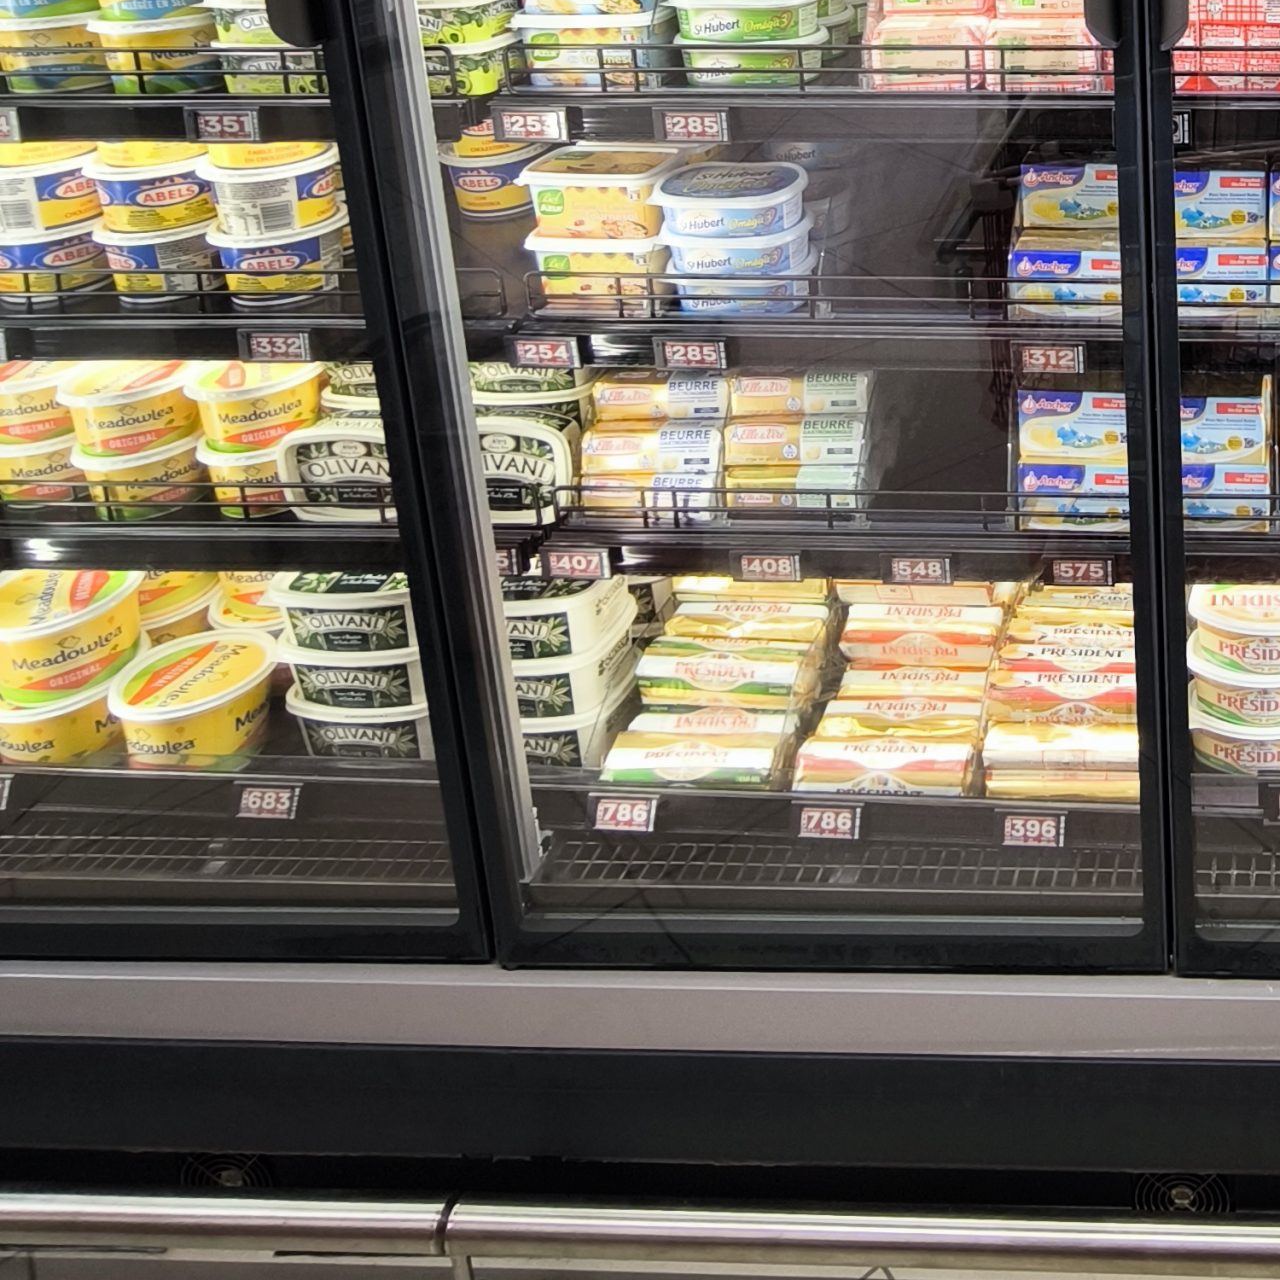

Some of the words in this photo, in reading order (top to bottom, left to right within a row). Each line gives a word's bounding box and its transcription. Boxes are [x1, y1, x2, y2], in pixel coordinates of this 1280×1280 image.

[703, 18, 740, 35] Hubert
[203, 116, 250, 133] 351
[675, 117, 717, 133] 285
[461, 177, 498, 187] ABELS
[1037, 172, 1076, 185] Anchor
[140, 185, 196, 204] ABELS
[690, 217, 724, 229] Hubert
[257, 338, 301, 354] 332
[523, 345, 568, 360] 254
[673, 346, 716, 361] 285
[1028, 350, 1075, 367] 312
[668, 380, 719, 391] BEURRE
[85, 403, 174, 430] Meadowlea
[218, 397, 302, 425] Meadowlea
[803, 420, 853, 431] BEURRE
[108, 431, 157, 449] ORIGINAL
[240, 424, 287, 444] ORIGINAL
[659, 429, 711, 441] BEURRE
[558, 556, 599, 571] 407
[750, 558, 791, 573] 408
[899, 560, 940, 576] 548
[1059, 562, 1104, 579] 575
[308, 615, 379, 631] OLIVANI
[12, 625, 123, 671] Meadowlea
[315, 672, 384, 687] OLIVANI
[323, 727, 393, 743] OLIVANI
[248, 791, 290, 809] 683
[603, 804, 648, 821] 786
[807, 812, 851, 829] 786
[1011, 819, 1056, 836] 396
